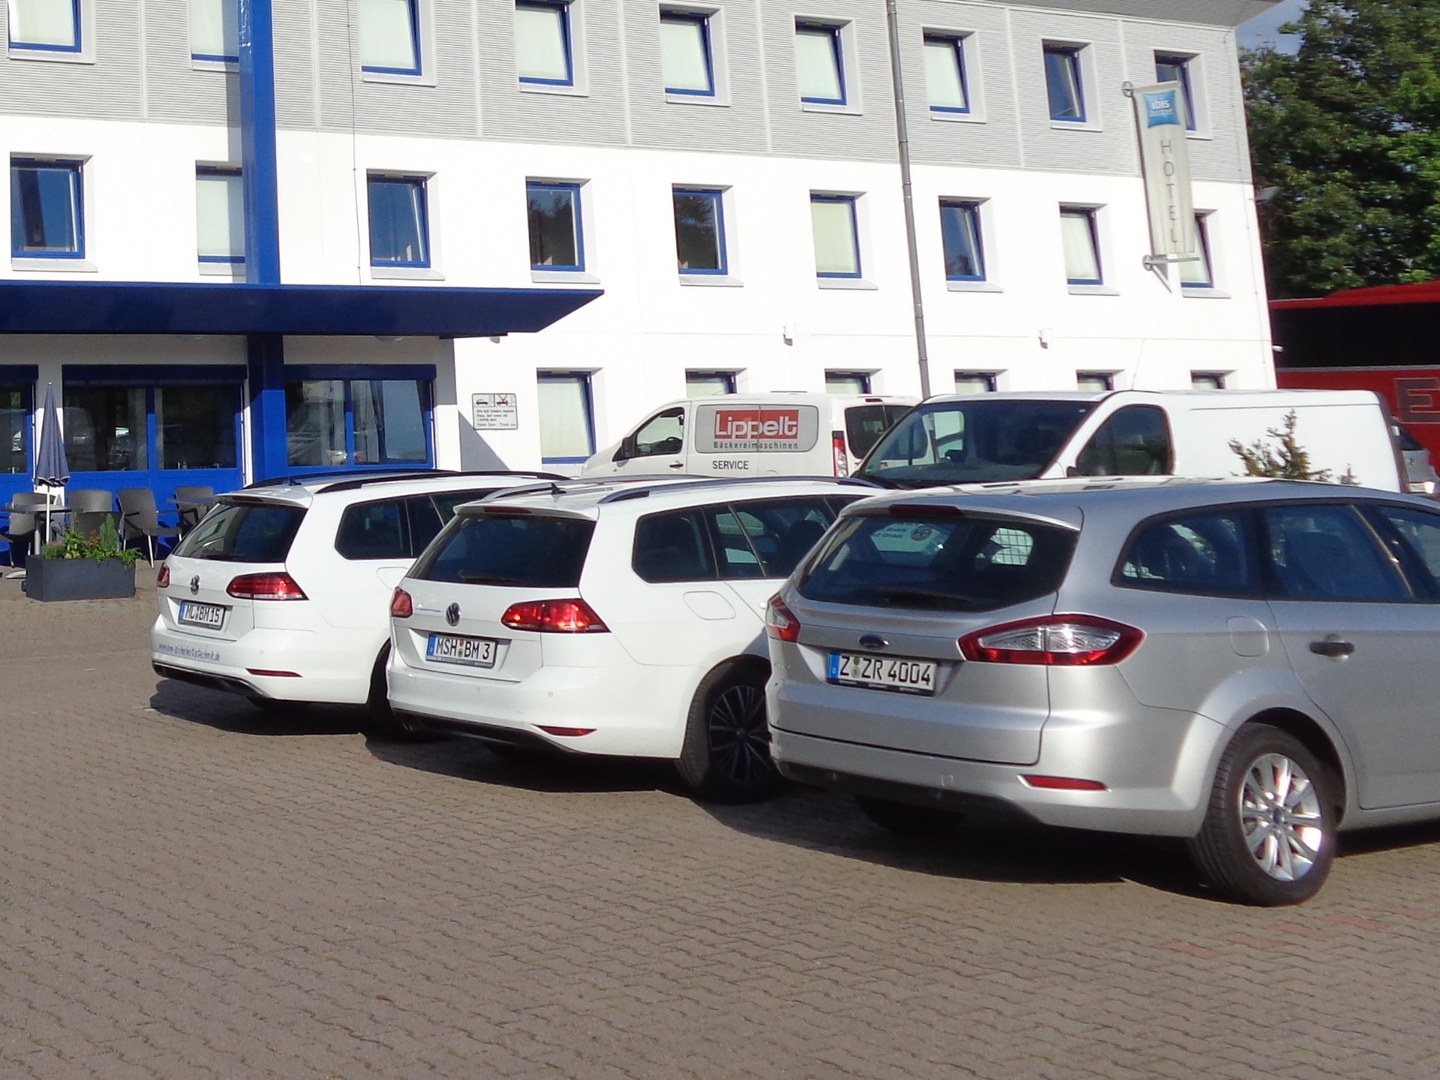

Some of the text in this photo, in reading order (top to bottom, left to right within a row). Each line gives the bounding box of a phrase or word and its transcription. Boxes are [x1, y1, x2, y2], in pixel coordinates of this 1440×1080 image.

[1160, 139, 1178, 243] HOTEL
[715, 413, 798, 439] Lippelt
[713, 440, 799, 450] Bäckereimaschinen
[712, 460, 750, 470] SERVICE
[435, 637, 491, 661] MSH BM 3
[840, 655, 932, 686] Z ZR 4004
